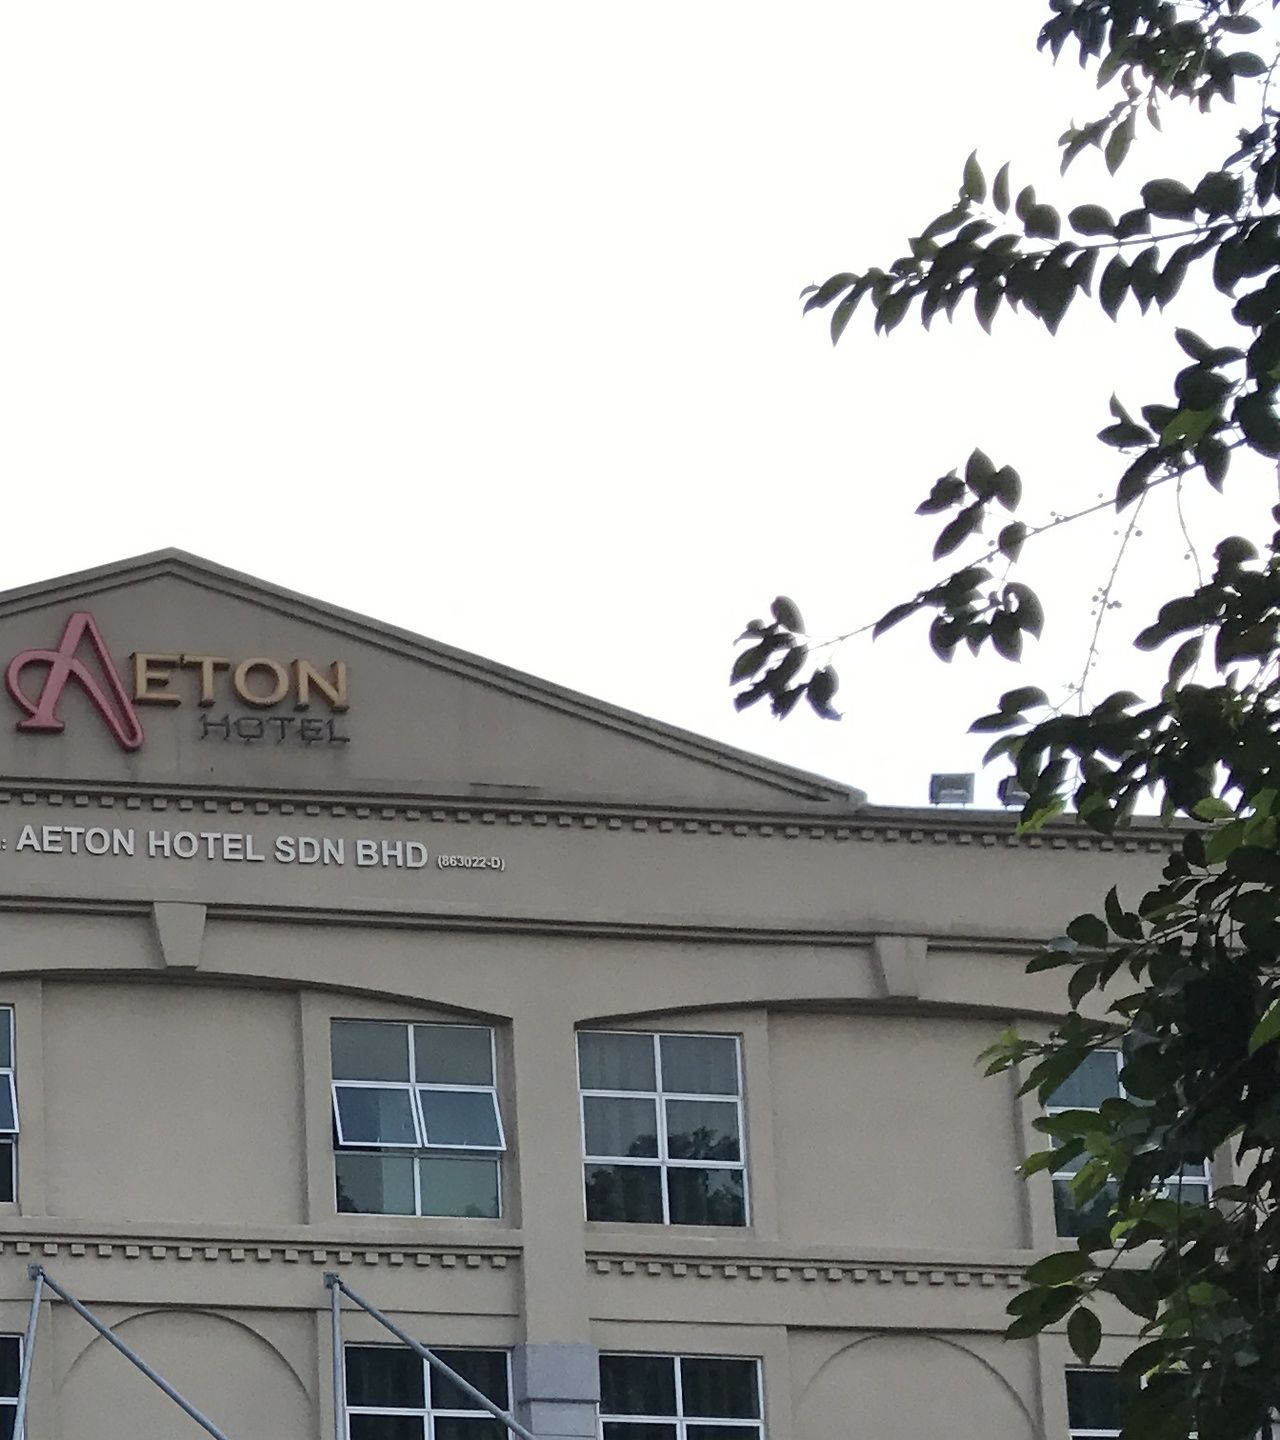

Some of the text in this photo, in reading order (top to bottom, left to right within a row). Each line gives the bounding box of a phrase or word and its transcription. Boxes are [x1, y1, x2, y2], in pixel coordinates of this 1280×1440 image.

[5, 611, 350, 750] AETON
[199, 713, 350, 744] HOTEL
[15, 824, 135, 857] AETON
[148, 830, 266, 862] HOTEL
[274, 835, 345, 865] SDN
[356, 839, 429, 869] BHD
[437, 855, 506, 871] (863022-D)
